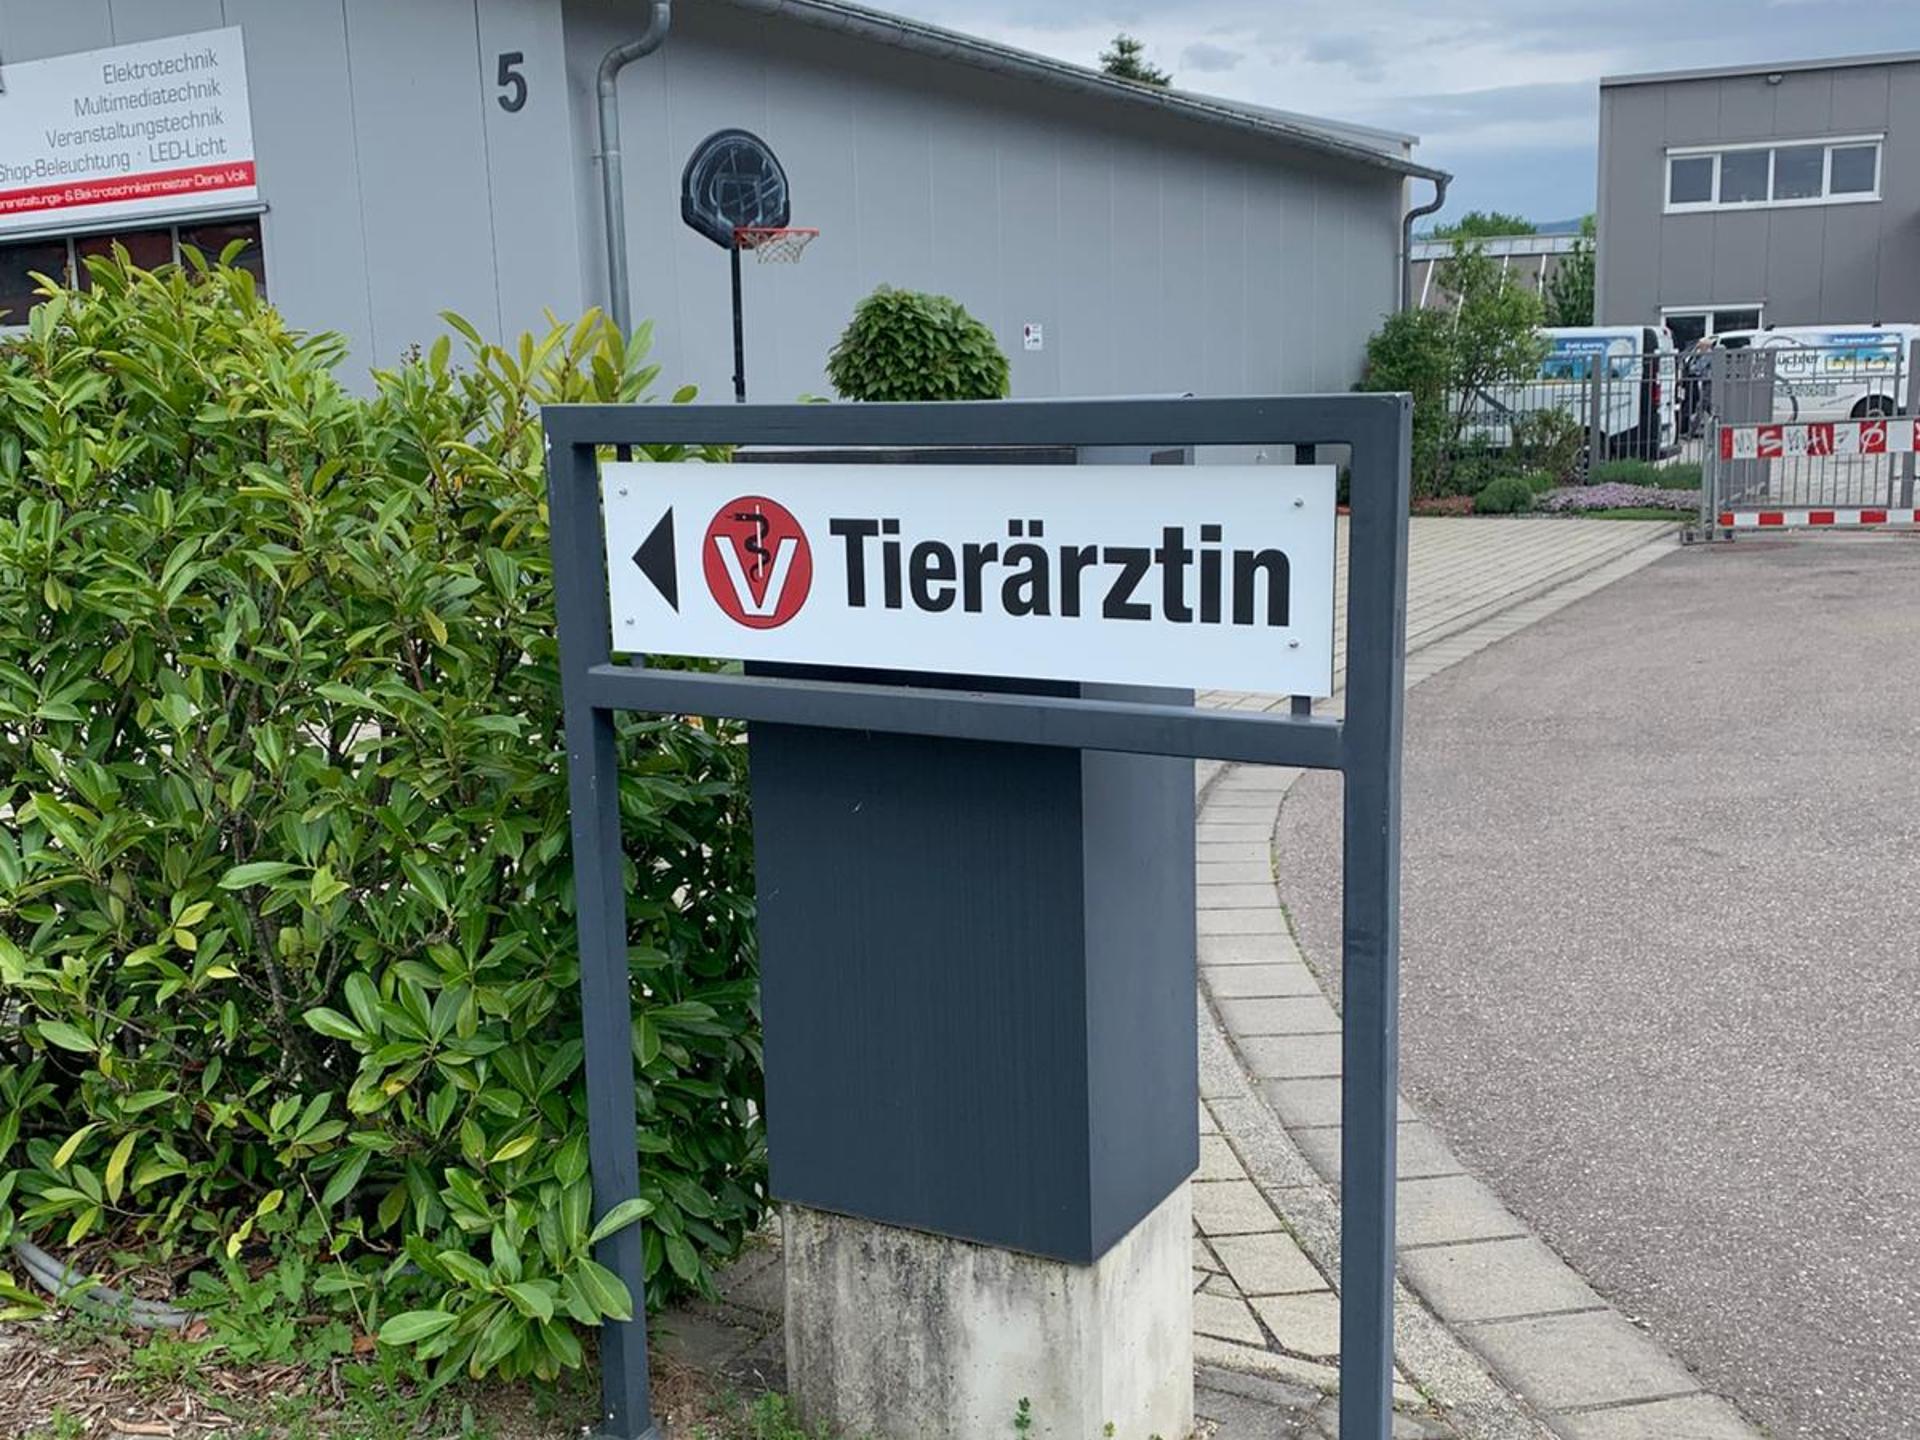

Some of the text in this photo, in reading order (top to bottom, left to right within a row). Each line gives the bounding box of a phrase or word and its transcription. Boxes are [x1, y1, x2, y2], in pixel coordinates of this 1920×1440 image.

[103, 48, 219, 84] Elektrotechnik
[497, 52, 527, 113] 5
[74, 78, 221, 117] Multimediatechnik
[46, 107, 224, 148] Veranstaltungstechnik
[149, 137, 228, 163] LED-Licht
[829, 517, 1291, 627] Tierärztin
